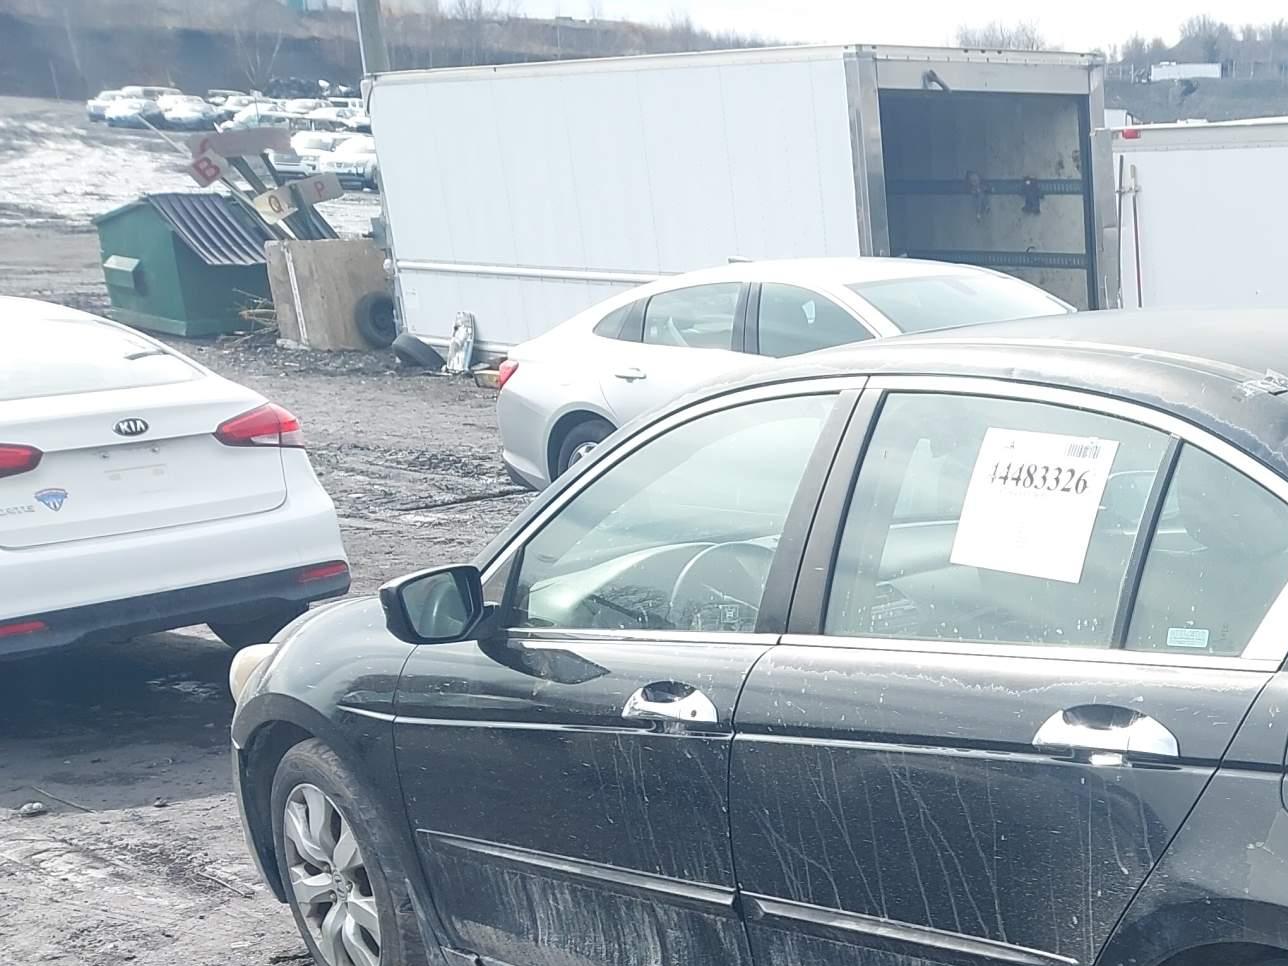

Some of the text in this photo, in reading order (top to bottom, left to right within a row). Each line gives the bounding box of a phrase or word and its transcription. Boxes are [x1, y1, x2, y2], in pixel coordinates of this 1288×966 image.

[192, 157, 220, 179] B
[313, 180, 325, 198] P
[267, 194, 284, 214] Q
[118, 419, 146, 435] KIA
